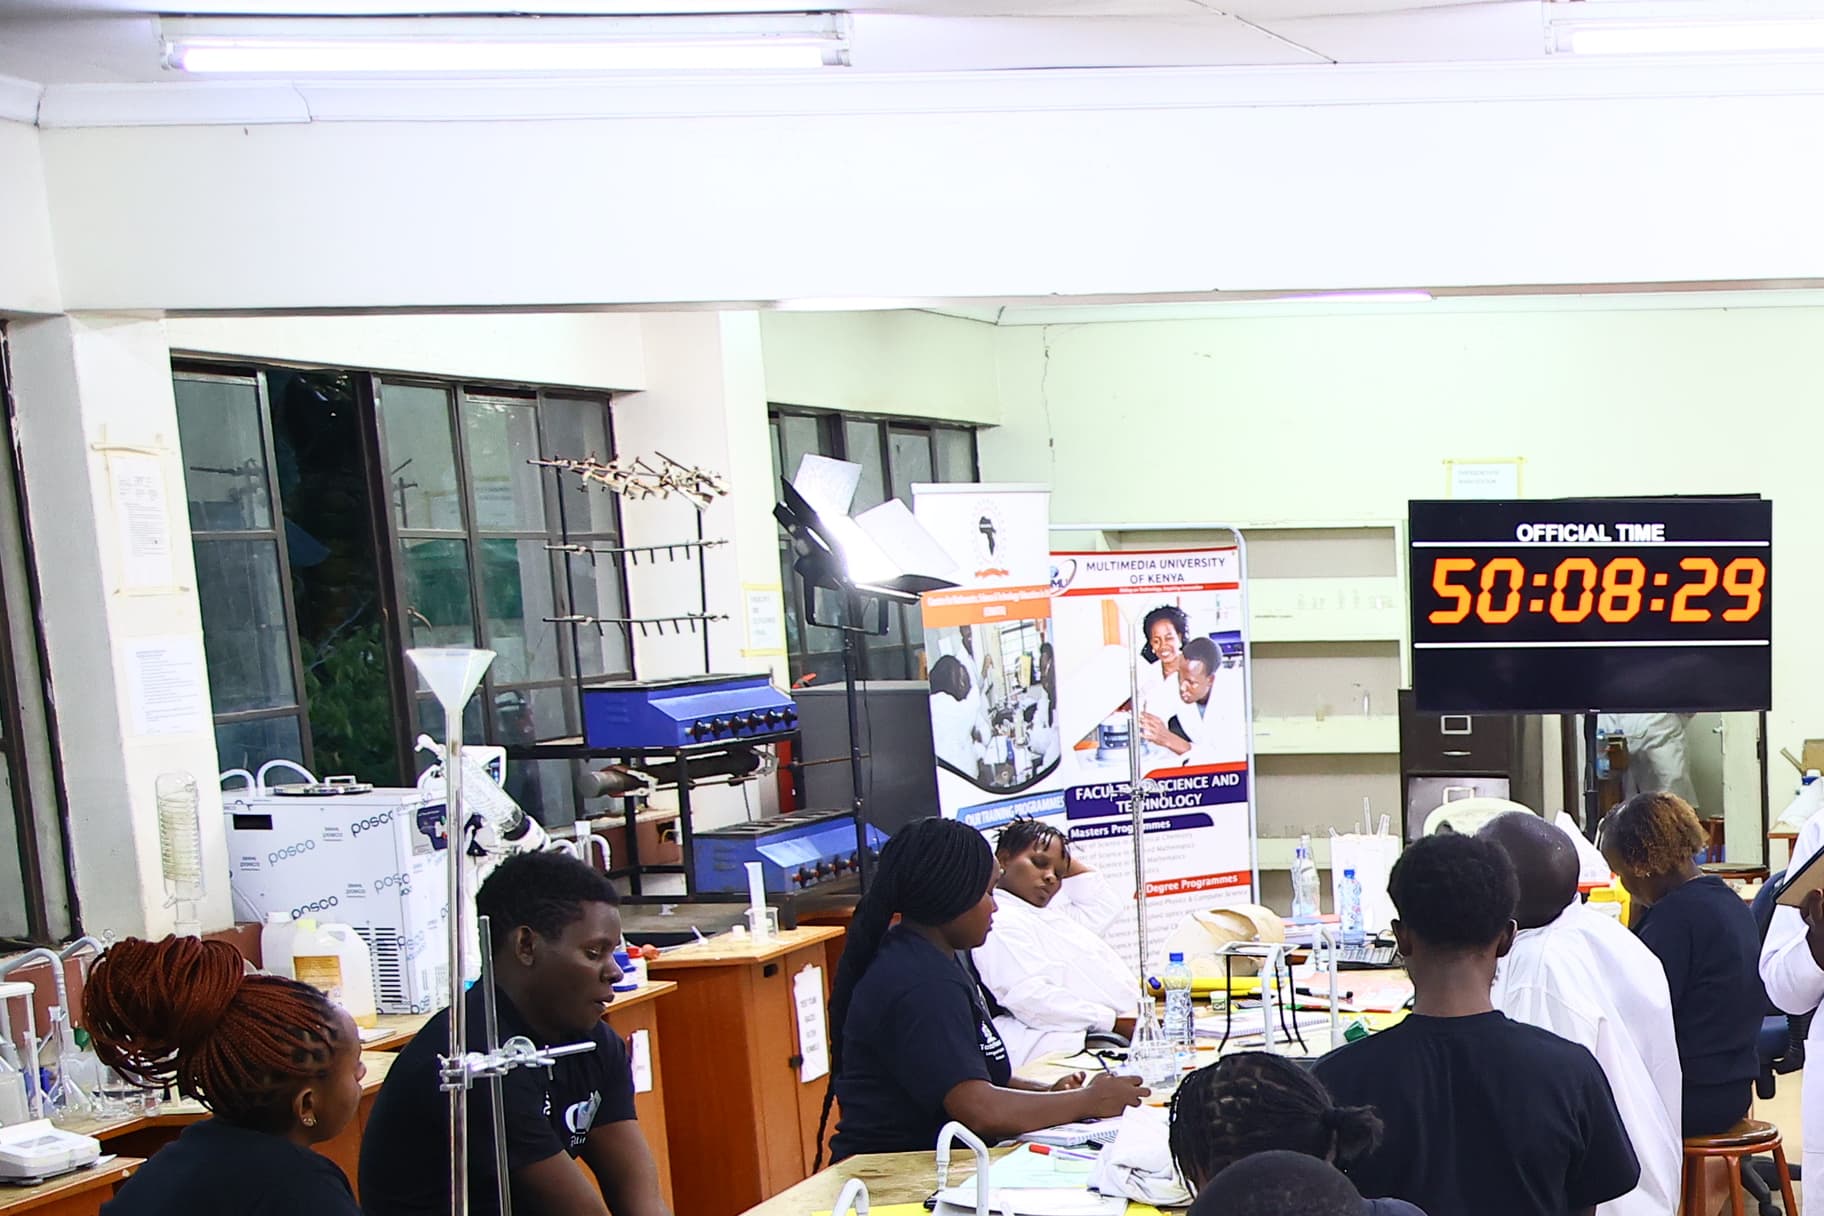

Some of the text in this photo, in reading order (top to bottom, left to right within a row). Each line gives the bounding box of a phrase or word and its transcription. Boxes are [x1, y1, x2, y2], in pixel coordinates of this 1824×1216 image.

[1516, 523, 1666, 542] OFFICIAL TIME
[1086, 557, 1225, 571] MULTIMEDIA UNIVERSITY
[1130, 573, 1185, 585] OF KENYA
[1428, 557, 1767, 624] 50:08:29
[1211, 773, 1240, 787] AND
[1116, 794, 1202, 813] TEHNOLOGY
[1070, 820, 1171, 839] Masters Progmmes
[268, 839, 316, 866] posco
[1147, 874, 1238, 894] Degree Programmes
